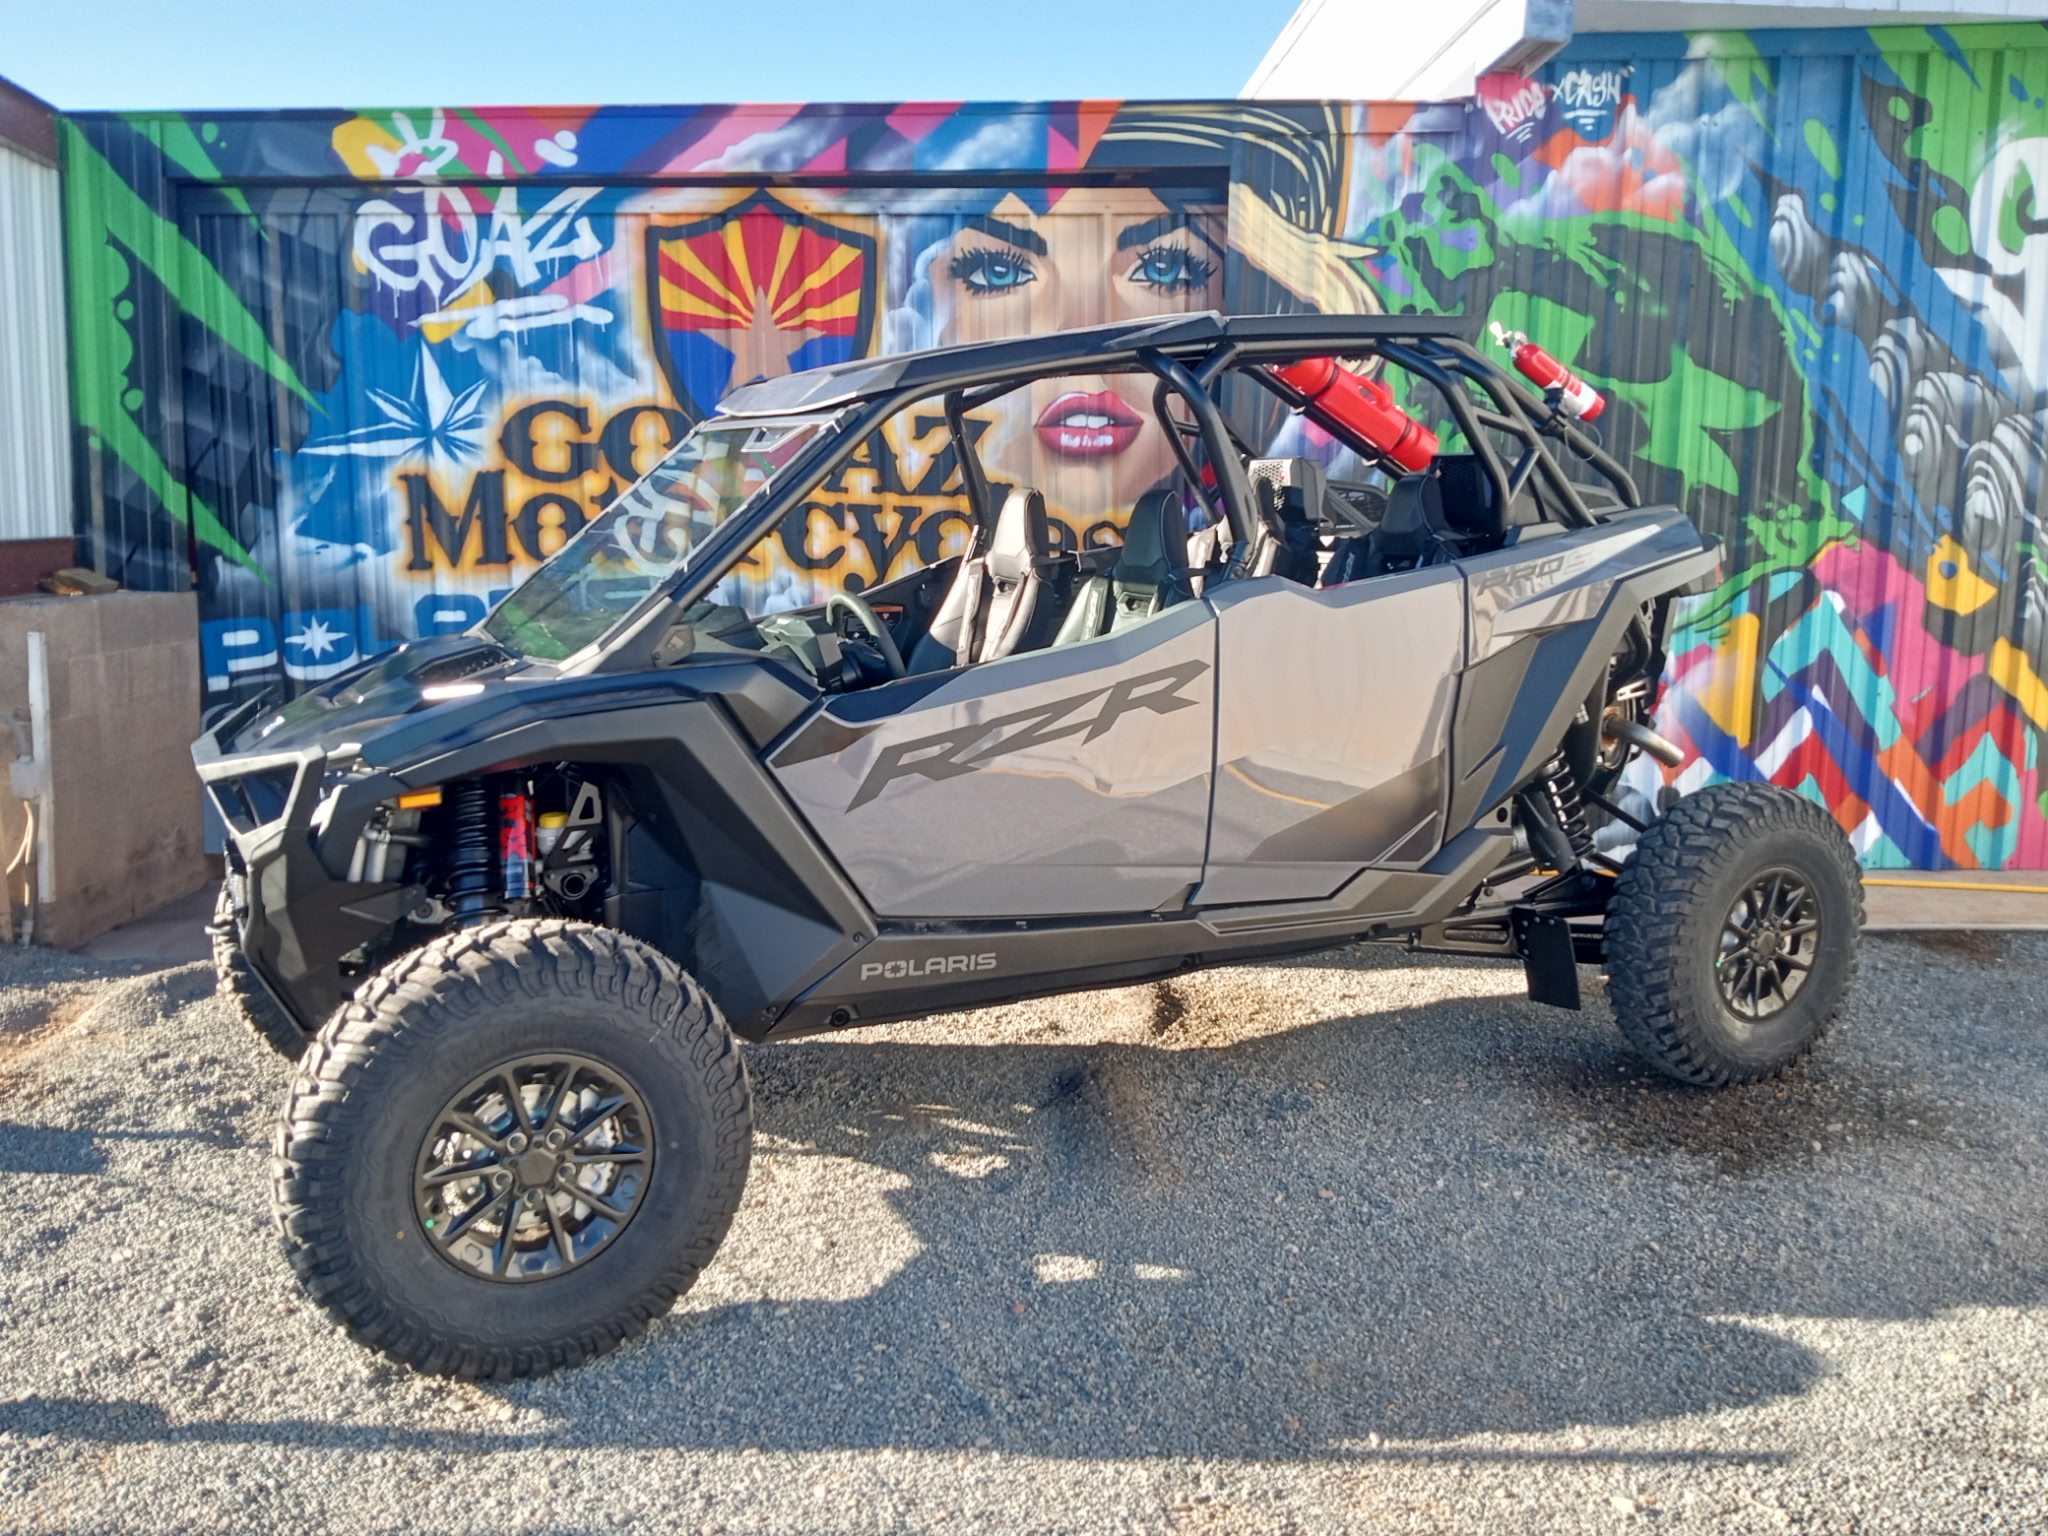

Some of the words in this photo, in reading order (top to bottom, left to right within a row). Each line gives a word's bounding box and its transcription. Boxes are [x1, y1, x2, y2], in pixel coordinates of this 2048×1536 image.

[499, 400, 698, 484] GO
[1477, 555, 1565, 597] PRO
[845, 659, 1211, 815] RZR
[860, 952, 997, 981] POLARIS
